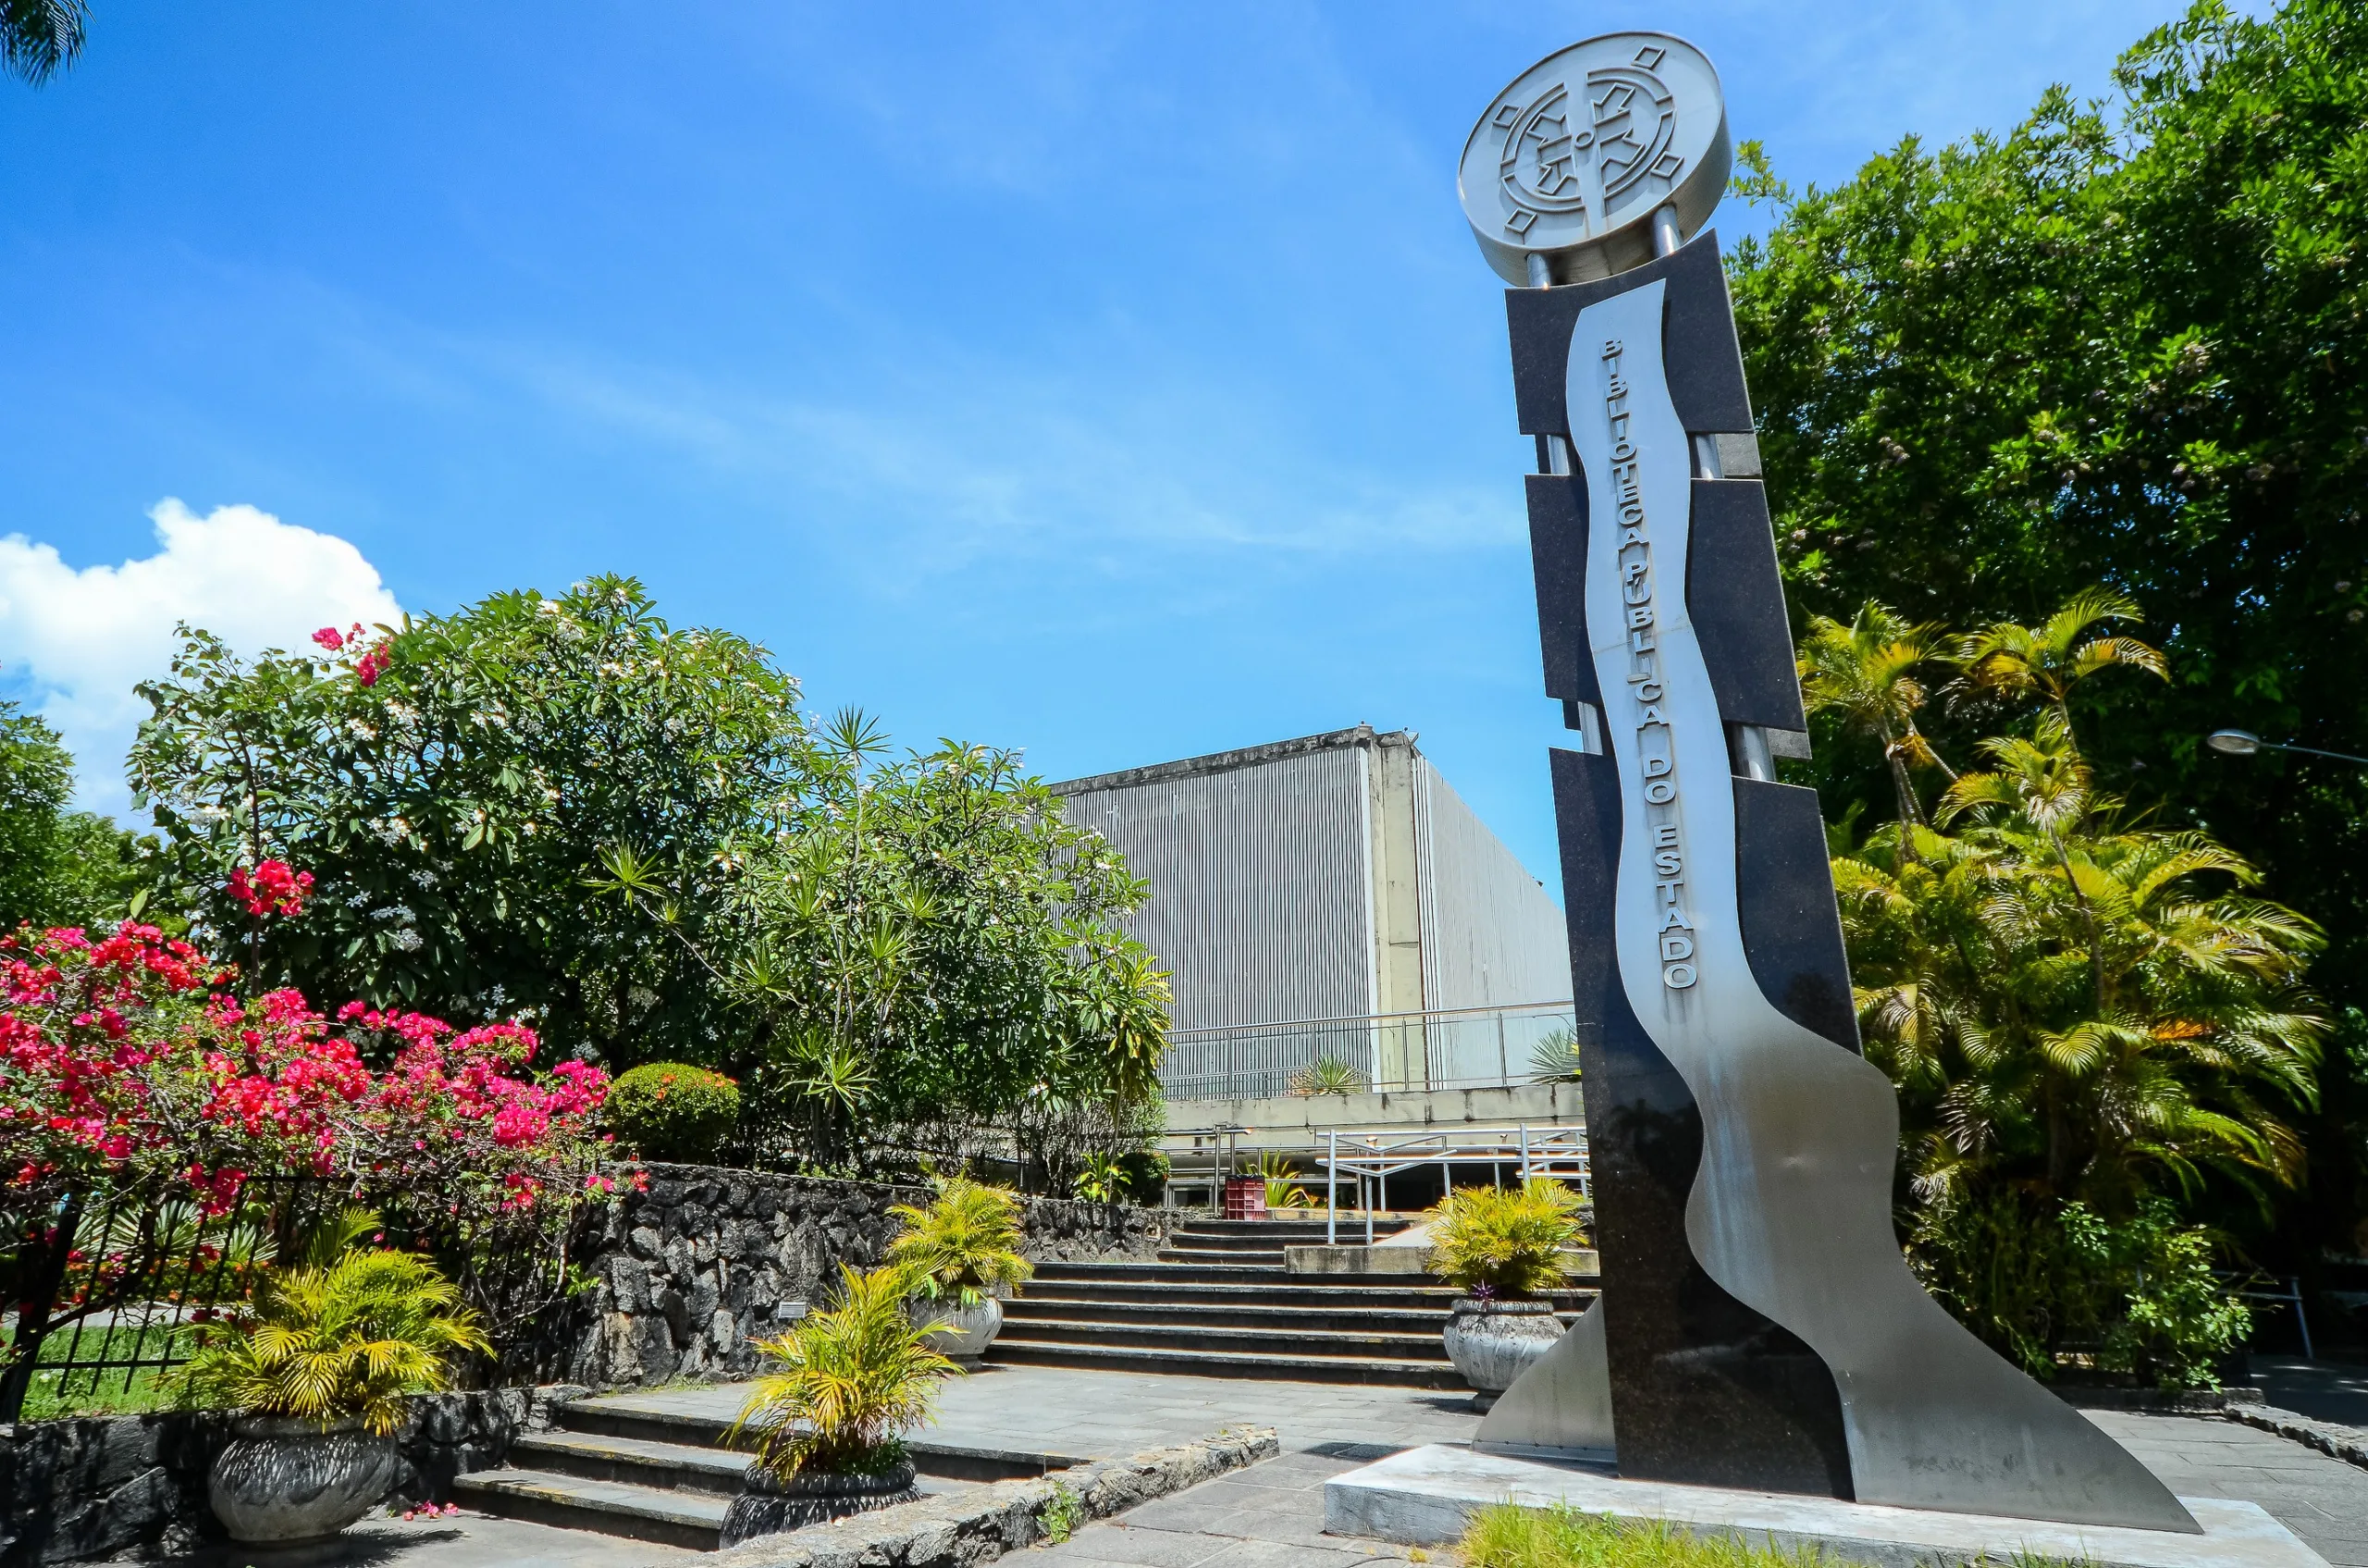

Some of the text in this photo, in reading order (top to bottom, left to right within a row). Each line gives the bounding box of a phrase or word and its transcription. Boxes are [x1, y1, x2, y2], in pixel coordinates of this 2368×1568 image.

[1600, 337, 1649, 550] BIBLIOTECA
[1643, 756, 1676, 804] DO
[1653, 823, 1697, 989] ESTADO
